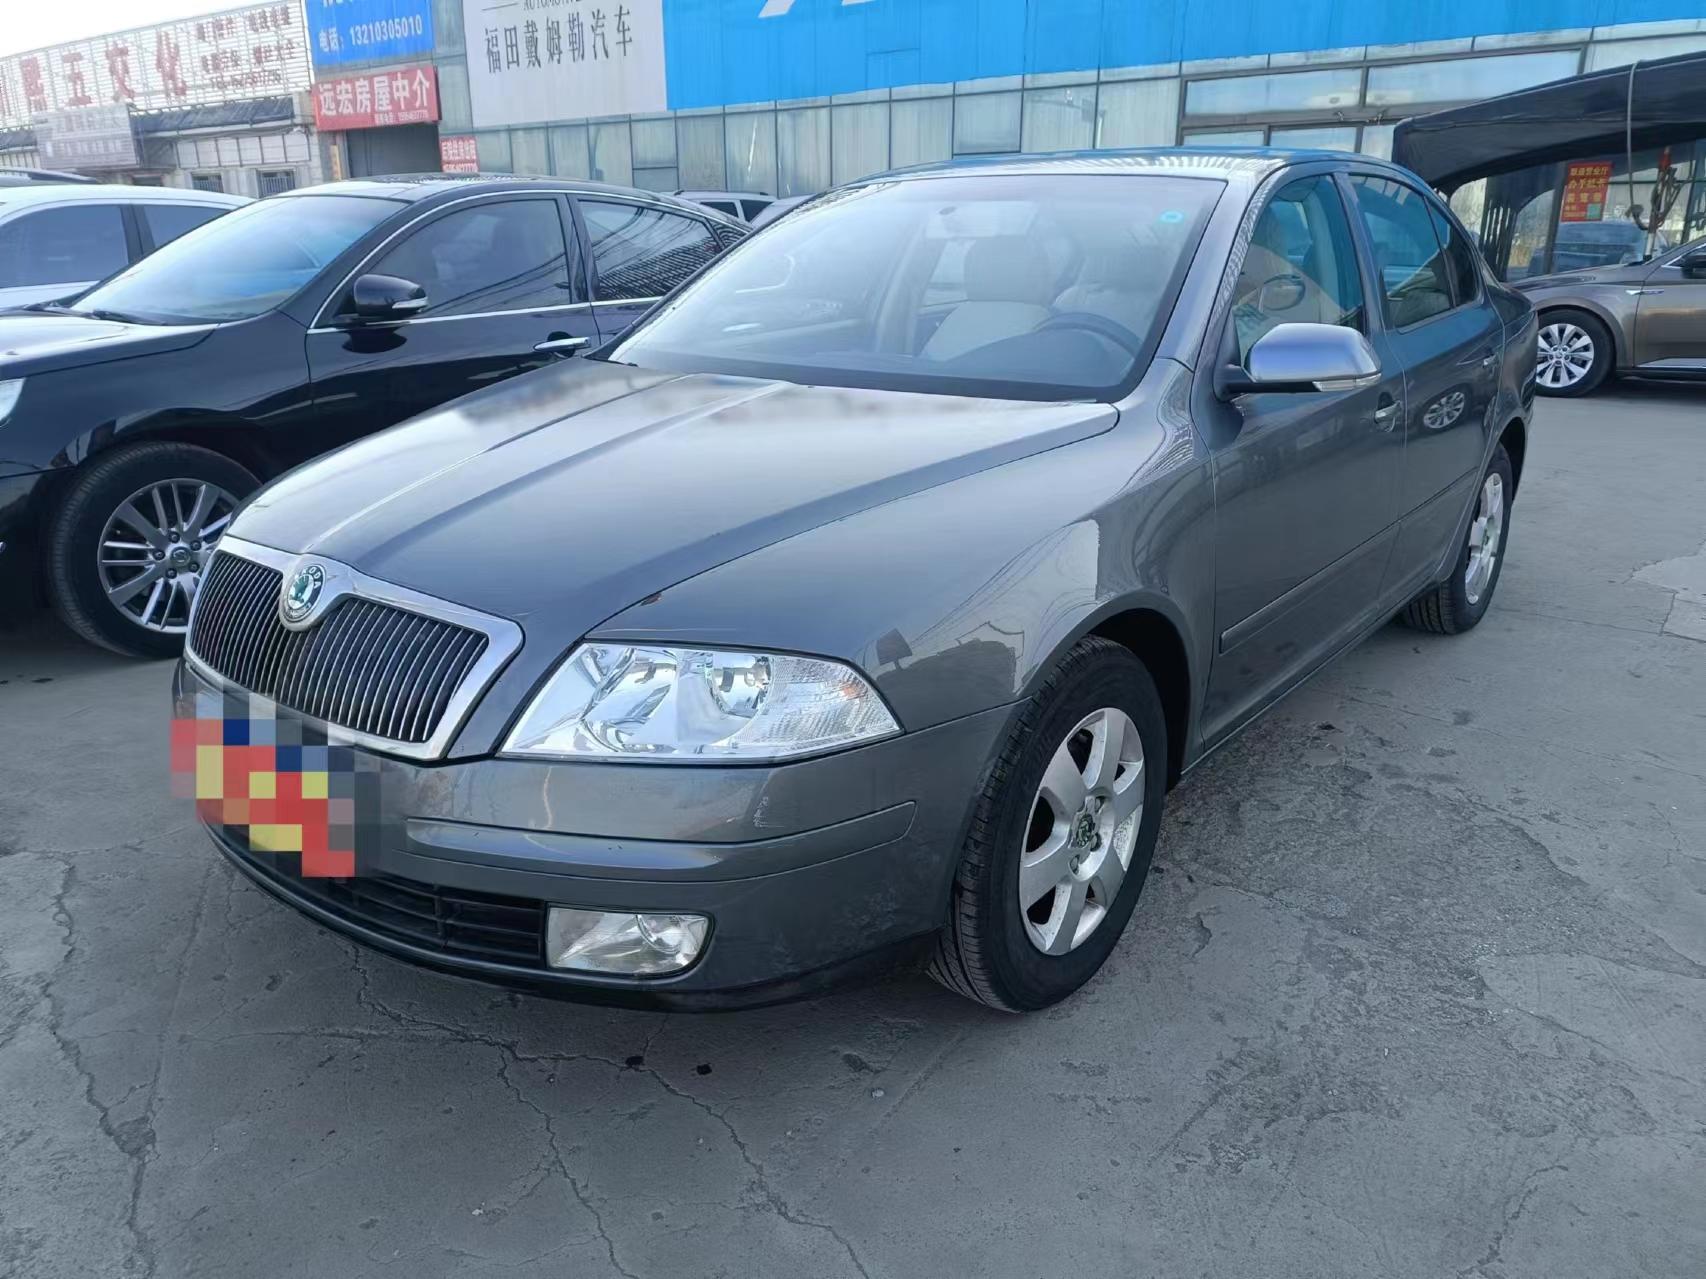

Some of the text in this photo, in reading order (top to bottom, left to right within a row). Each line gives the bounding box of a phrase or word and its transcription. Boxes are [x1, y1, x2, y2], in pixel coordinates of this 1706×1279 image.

[349, 14, 423, 46] 13210305010
[484, 4, 633, 74] 福田戴姆勒汽车
[318, 68, 430, 116] 远宏房屋中介
